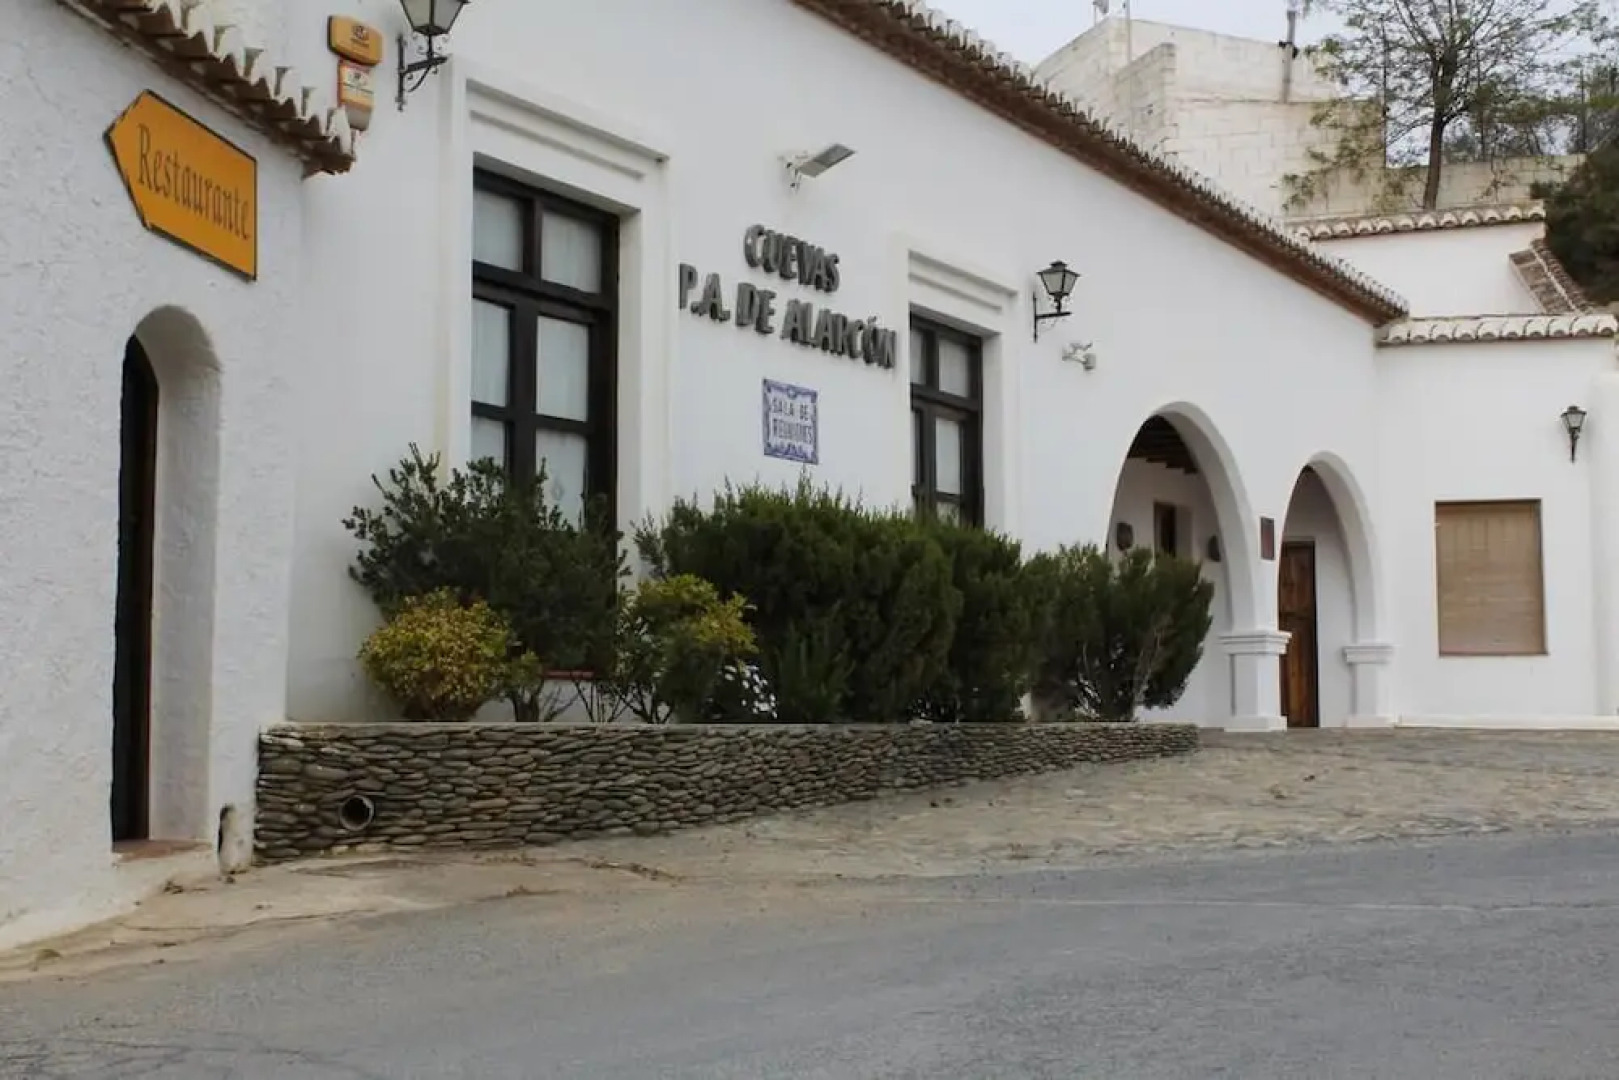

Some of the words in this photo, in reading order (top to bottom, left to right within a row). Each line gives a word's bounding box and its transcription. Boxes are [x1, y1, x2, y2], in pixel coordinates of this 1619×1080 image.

[137, 123, 250, 240] Restaurante
[744, 224, 840, 293] CUEVAS
[679, 263, 731, 322] P.A.
[735, 282, 776, 334] DE
[779, 299, 897, 369] ALARCÓN
